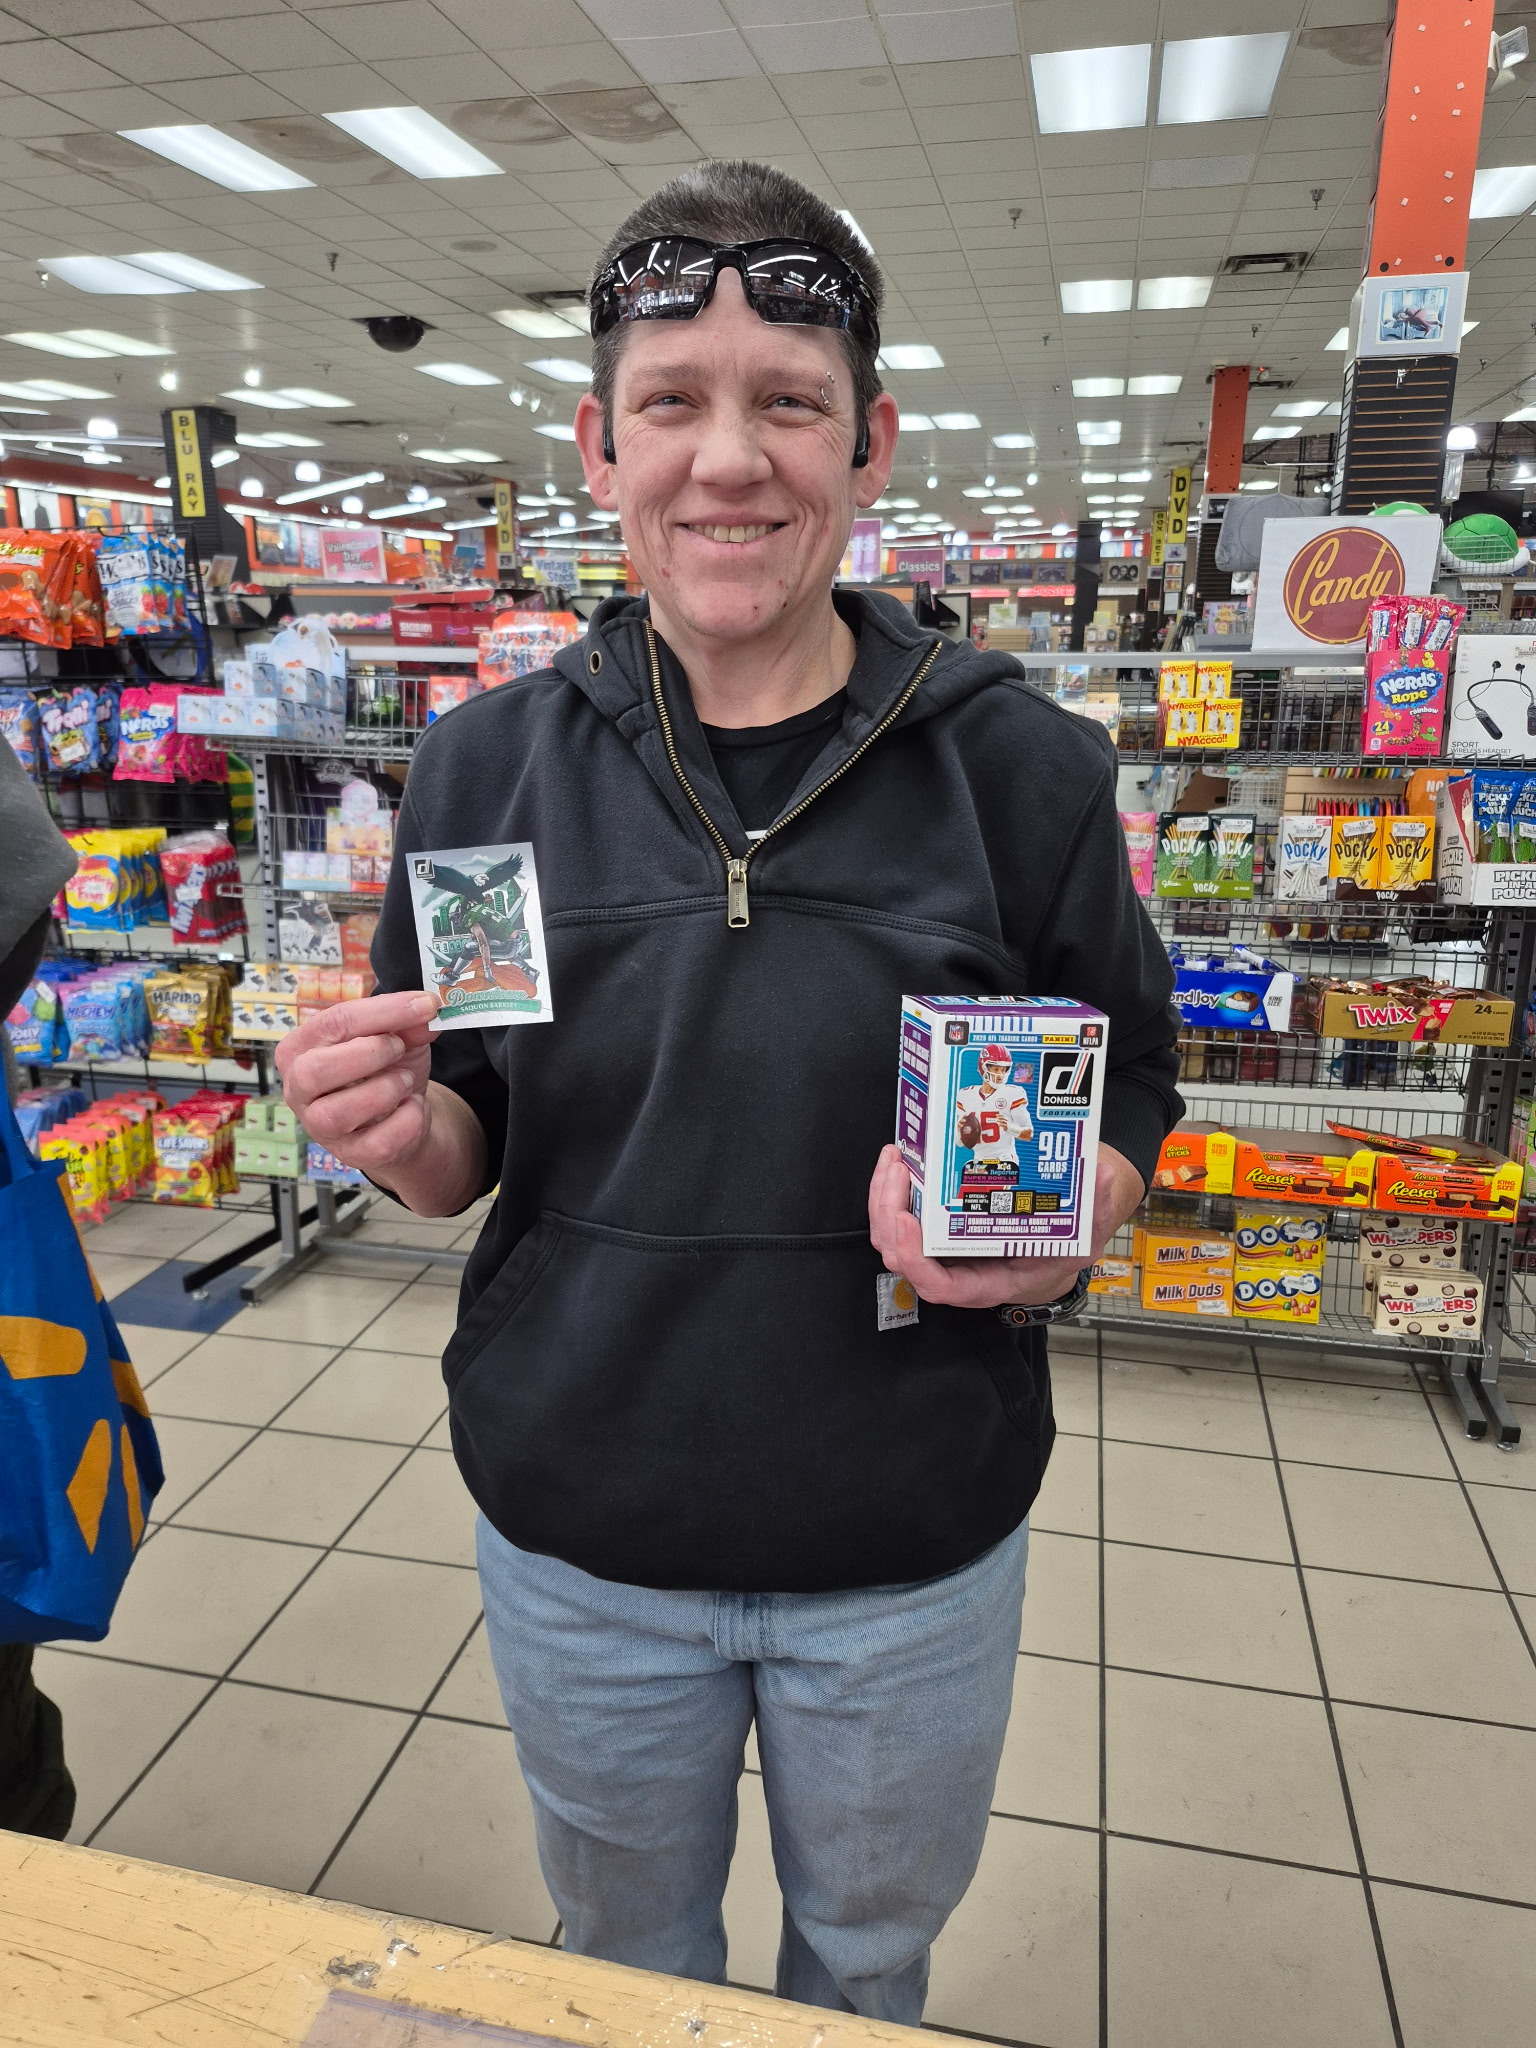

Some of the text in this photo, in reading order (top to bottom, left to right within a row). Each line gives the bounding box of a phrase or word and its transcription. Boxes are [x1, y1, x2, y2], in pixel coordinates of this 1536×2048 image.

[179, 416, 198, 510] BLU RAY
[1172, 476, 1187, 534] DVD
[498, 492, 510, 544] DVD
[535, 560, 574, 574] Vintage
[898, 561, 940, 572] Classics
[548, 572, 574, 582] Stock
[1294, 537, 1394, 636] Candy
[1410, 706, 1440, 716] rainbow
[1374, 721, 1390, 732] 24
[1161, 836, 1206, 857] Pocky
[1208, 838, 1253, 859] Pocky
[1284, 840, 1328, 861] Pocky
[1334, 844, 1378, 862] Pocky
[1386, 844, 1431, 862] Pocky
[1193, 882, 1220, 894] Pocky
[1376, 890, 1400, 901] Pocky
[152, 990, 202, 1005] HARIBO
[1194, 990, 1220, 1008] Joy
[460, 1004, 489, 1012] SAQUON
[1350, 1002, 1416, 1028] Twix
[1474, 1005, 1492, 1014] 24
[998, 1034, 1020, 1043] TRADING
[1021, 1035, 1038, 1043] CARDS
[1082, 1037, 1099, 1045] NFLPA
[1043, 1095, 1088, 1105] DONRUSS
[1038, 1132, 1070, 1160] 90
[1038, 1162, 1068, 1173] CARDS
[1245, 1168, 1296, 1186] Reese's
[1387, 1181, 1440, 1199] Reese's
[1158, 1248, 1186, 1262] Milk
[1154, 1283, 1223, 1300] Milk Duds
[884, 1312, 914, 1321] carhartt
